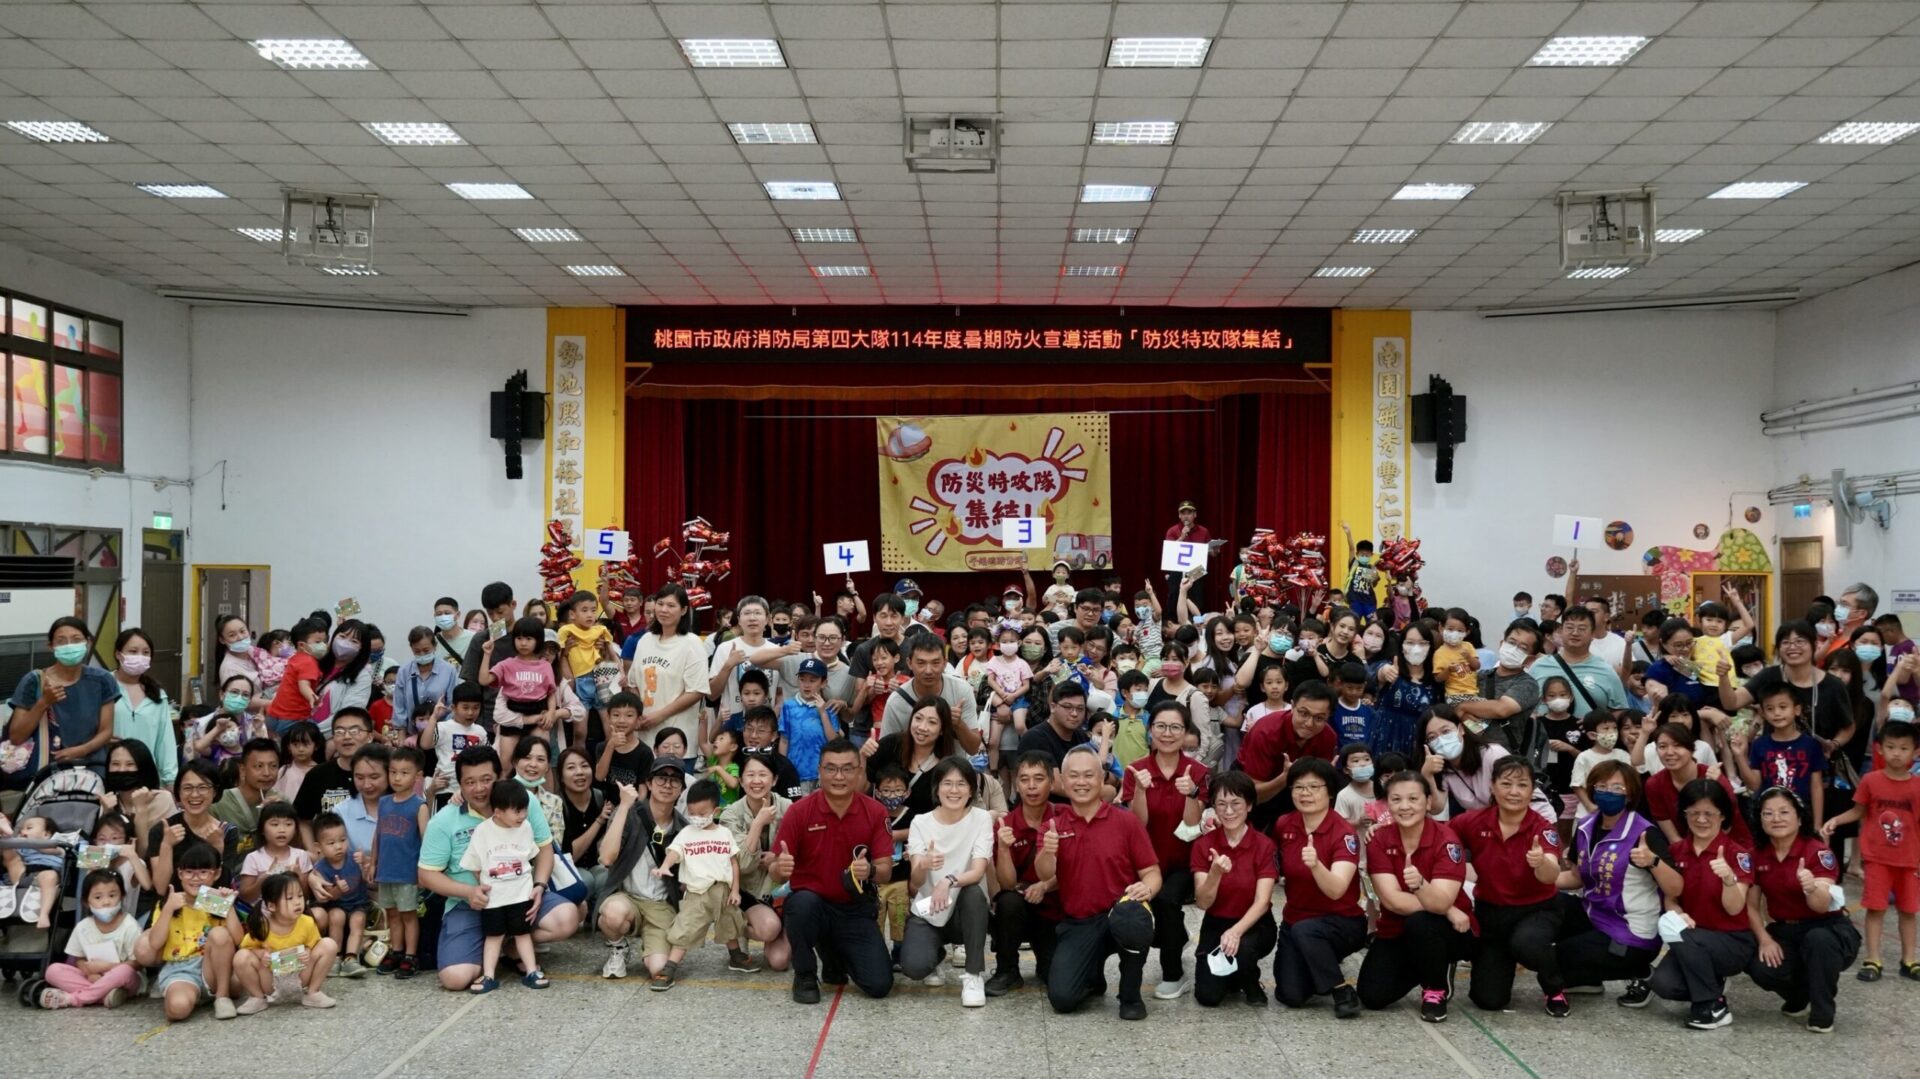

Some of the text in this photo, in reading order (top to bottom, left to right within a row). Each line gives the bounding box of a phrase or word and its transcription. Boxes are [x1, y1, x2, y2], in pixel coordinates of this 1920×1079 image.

[653, 328, 1294, 350] 桃園市政府消防局第四大隊114年度暑期防火宣導活動「防災特攻隊集結」
[940, 470, 1057, 495] 防災特攻隊
[1018, 519, 1031, 543] 3
[1573, 520, 1580, 541] 1
[598, 532, 614, 555] 5
[838, 545, 854, 567] 4
[1177, 544, 1194, 566] 2
